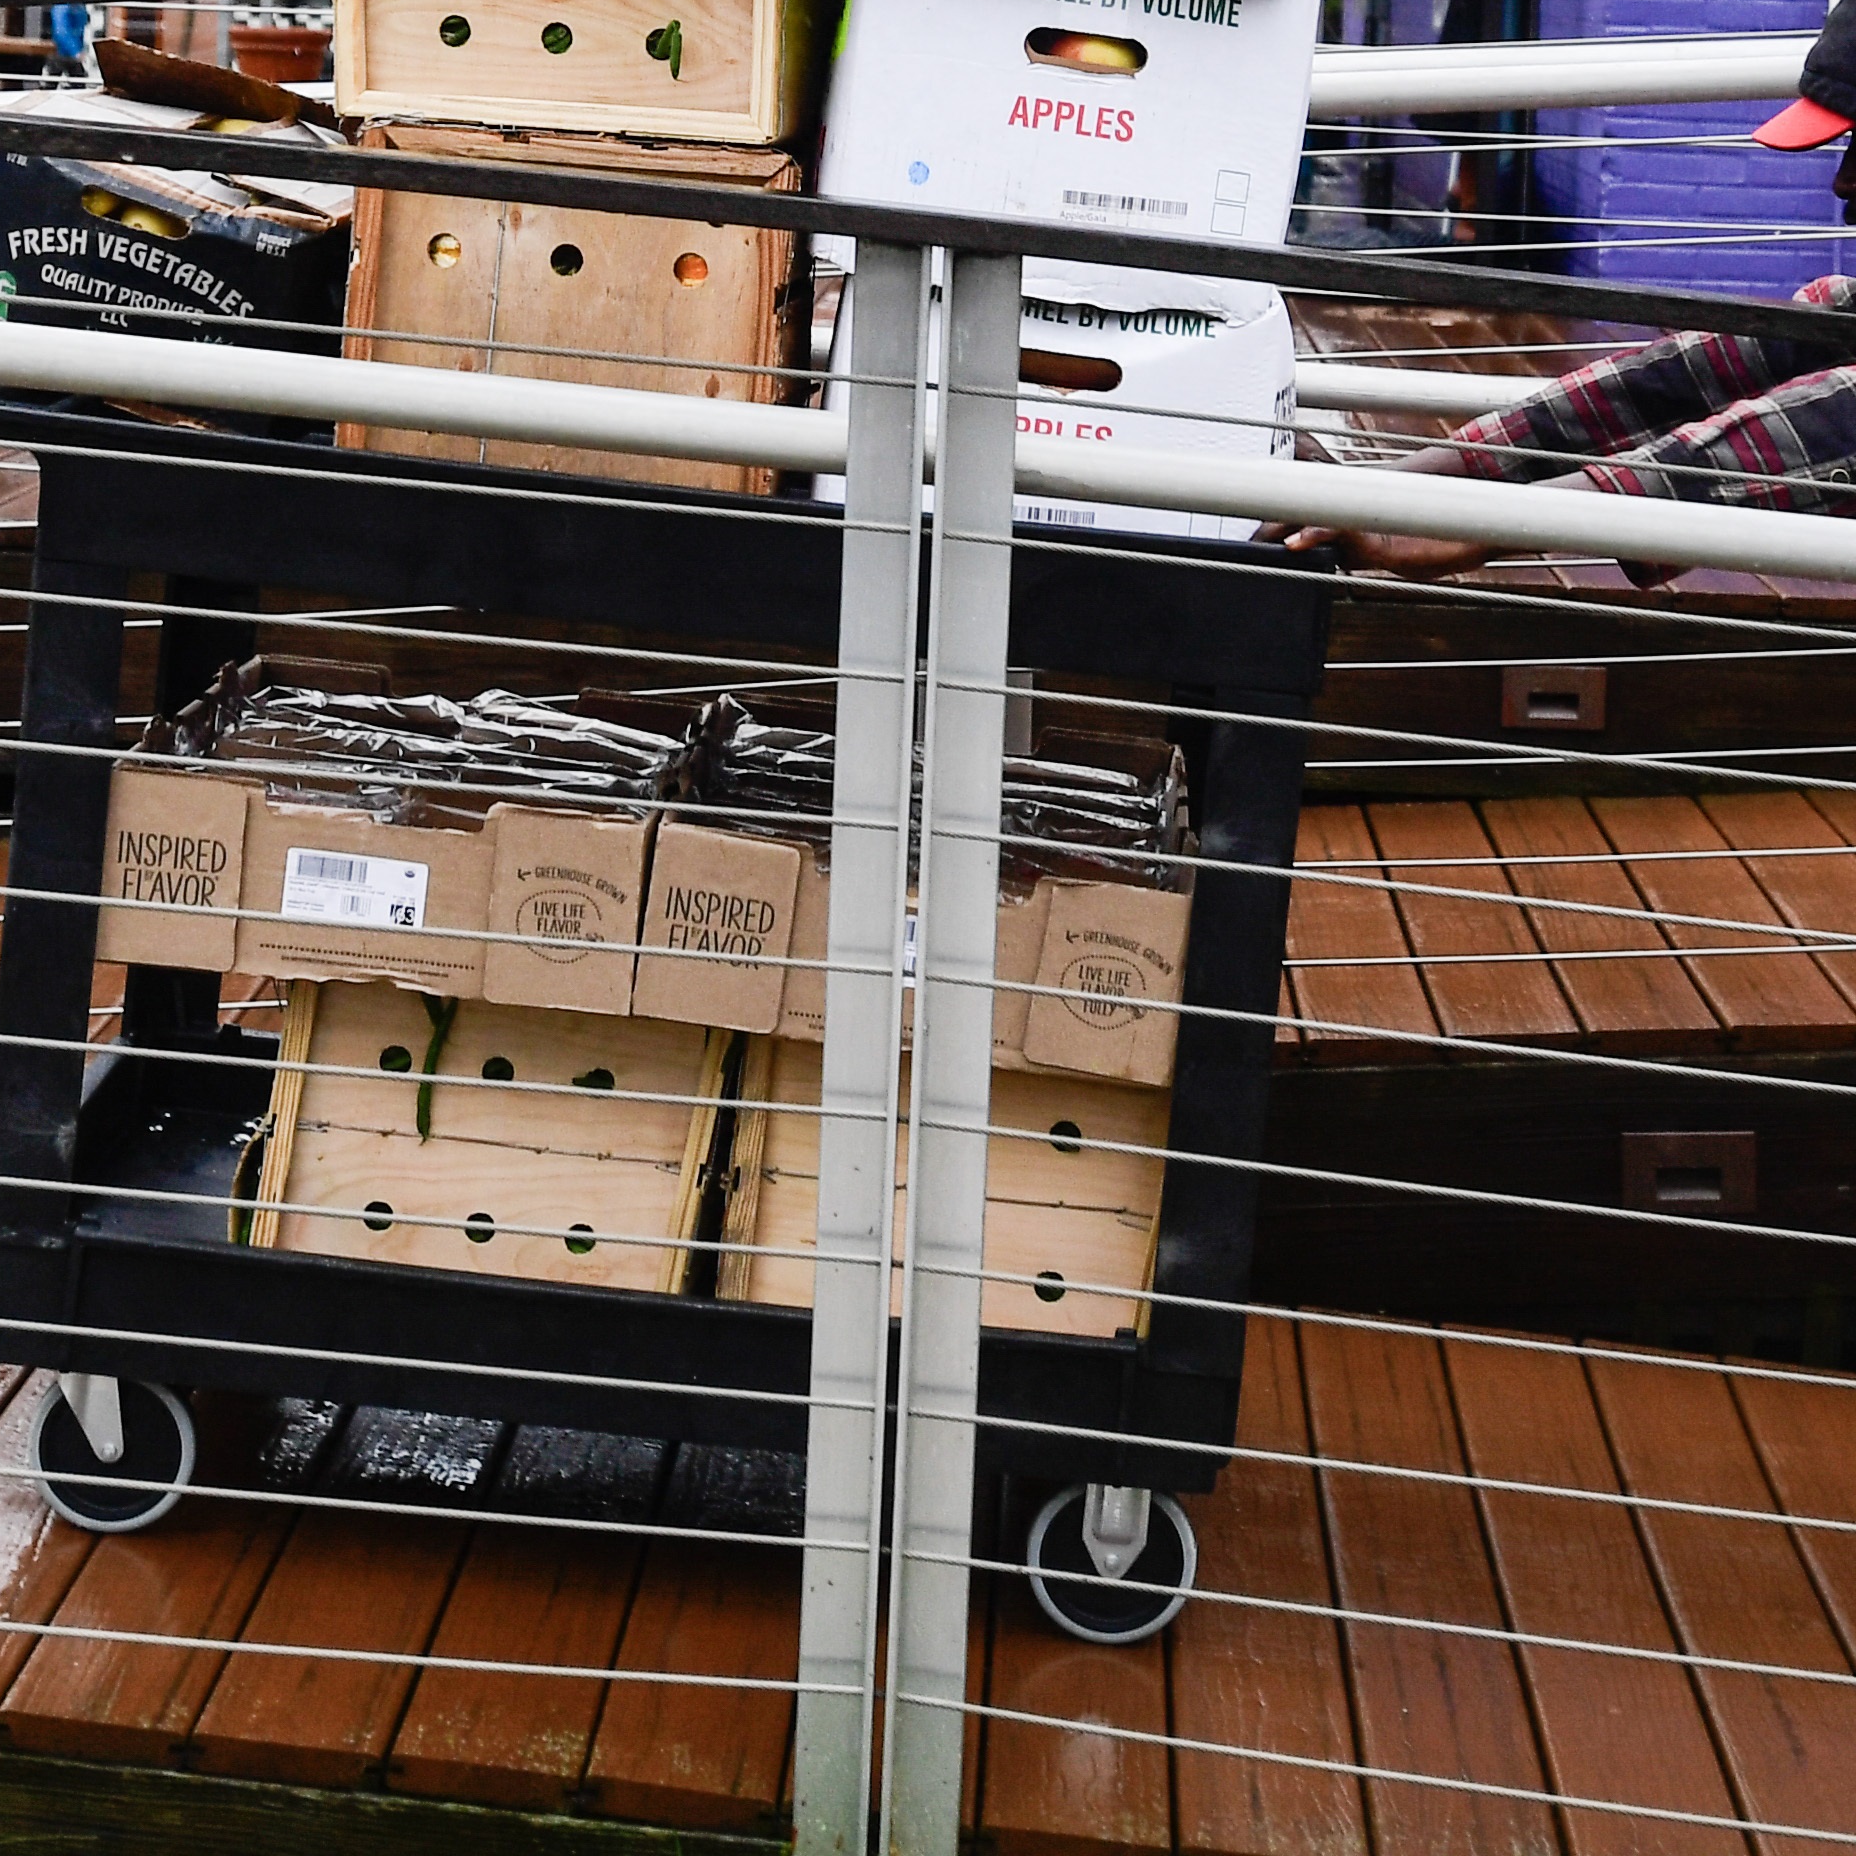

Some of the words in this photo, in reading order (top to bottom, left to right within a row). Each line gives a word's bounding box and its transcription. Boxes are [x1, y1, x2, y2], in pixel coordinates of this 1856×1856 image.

[1008, 96, 1135, 143] APPLES
[257, 231, 292, 247] PRODUCE
[8, 227, 88, 260] FRESH
[97, 231, 255, 318] VEGETABLES
[41, 264, 117, 302] QUALITY
[1078, 305, 1111, 331] BY
[1118, 310, 1217, 339] VOLUME
[118, 830, 227, 873] INSPIRED
[122, 868, 216, 907] FLAVOR
[535, 866, 593, 886] GREENHOUSE
[596, 878, 628, 904] GROWN
[534, 901, 561, 917] LIVE
[563, 904, 586, 920] LIFE
[537, 917, 581, 934] FLAVOR
[665, 886, 775, 934] INSPIRED
[669, 924, 762, 970] FLAVOR
[1083, 930, 1141, 954] GREENHOUSE
[1143, 947, 1174, 976] GROWN
[1078, 964, 1104, 982] LIVE
[1108, 970, 1132, 987] LIFE
